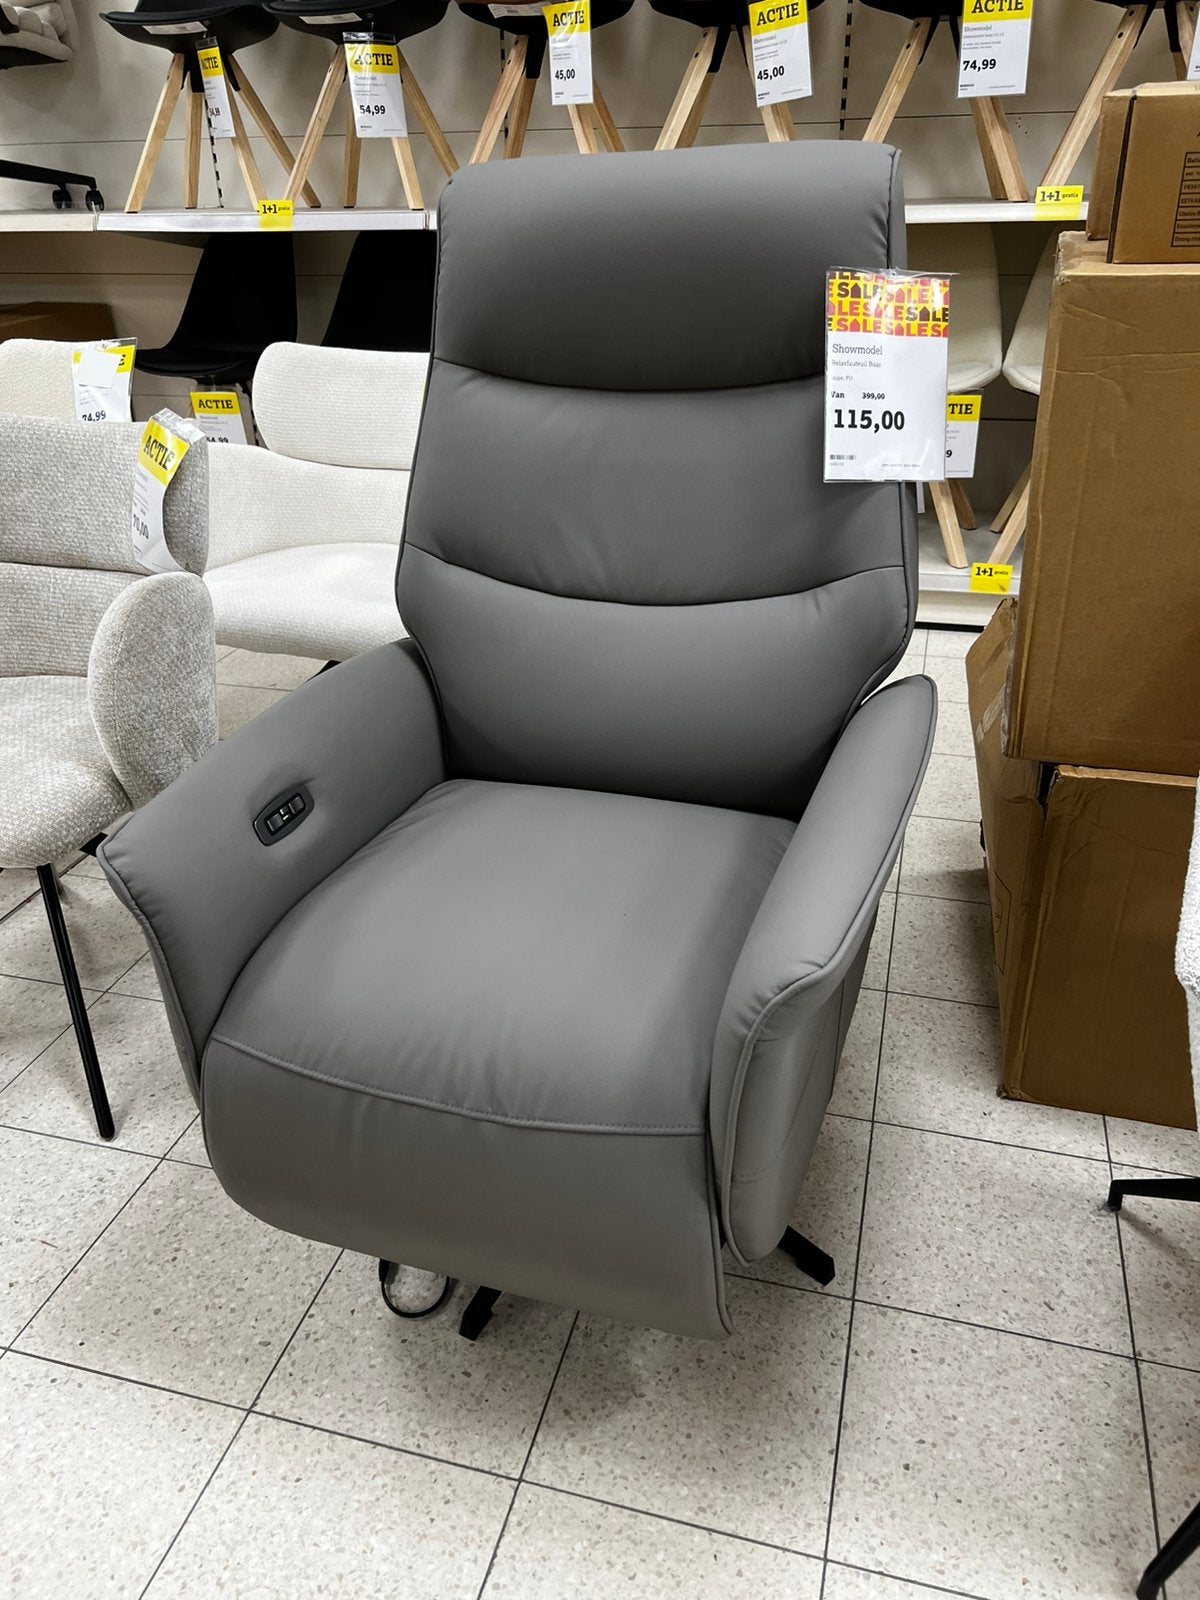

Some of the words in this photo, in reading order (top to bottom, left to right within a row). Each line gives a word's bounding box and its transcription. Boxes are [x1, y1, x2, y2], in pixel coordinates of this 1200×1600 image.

[971, 0, 1024, 14] ACTIE
[552, 10, 585, 27] ACTIE
[756, 2, 800, 26] ACTIE
[354, 53, 394, 66] ACTIE
[962, 58, 997, 72] 74,99
[554, 69, 576, 81] 45,00
[756, 65, 785, 81] 45,00
[359, 104, 386, 116] 54,99
[1040, 190, 1061, 202] 1+1
[262, 204, 278, 214] 1+1
[832, 343, 883, 355] Showmodel
[831, 391, 845, 399] Van
[861, 392, 886, 400] 399,00
[198, 399, 234, 409] ACTIE
[948, 403, 973, 415] TIE
[834, 408, 905, 434] 115,00
[143, 435, 175, 471] ACTIE
[975, 566, 993, 577] 1+1
